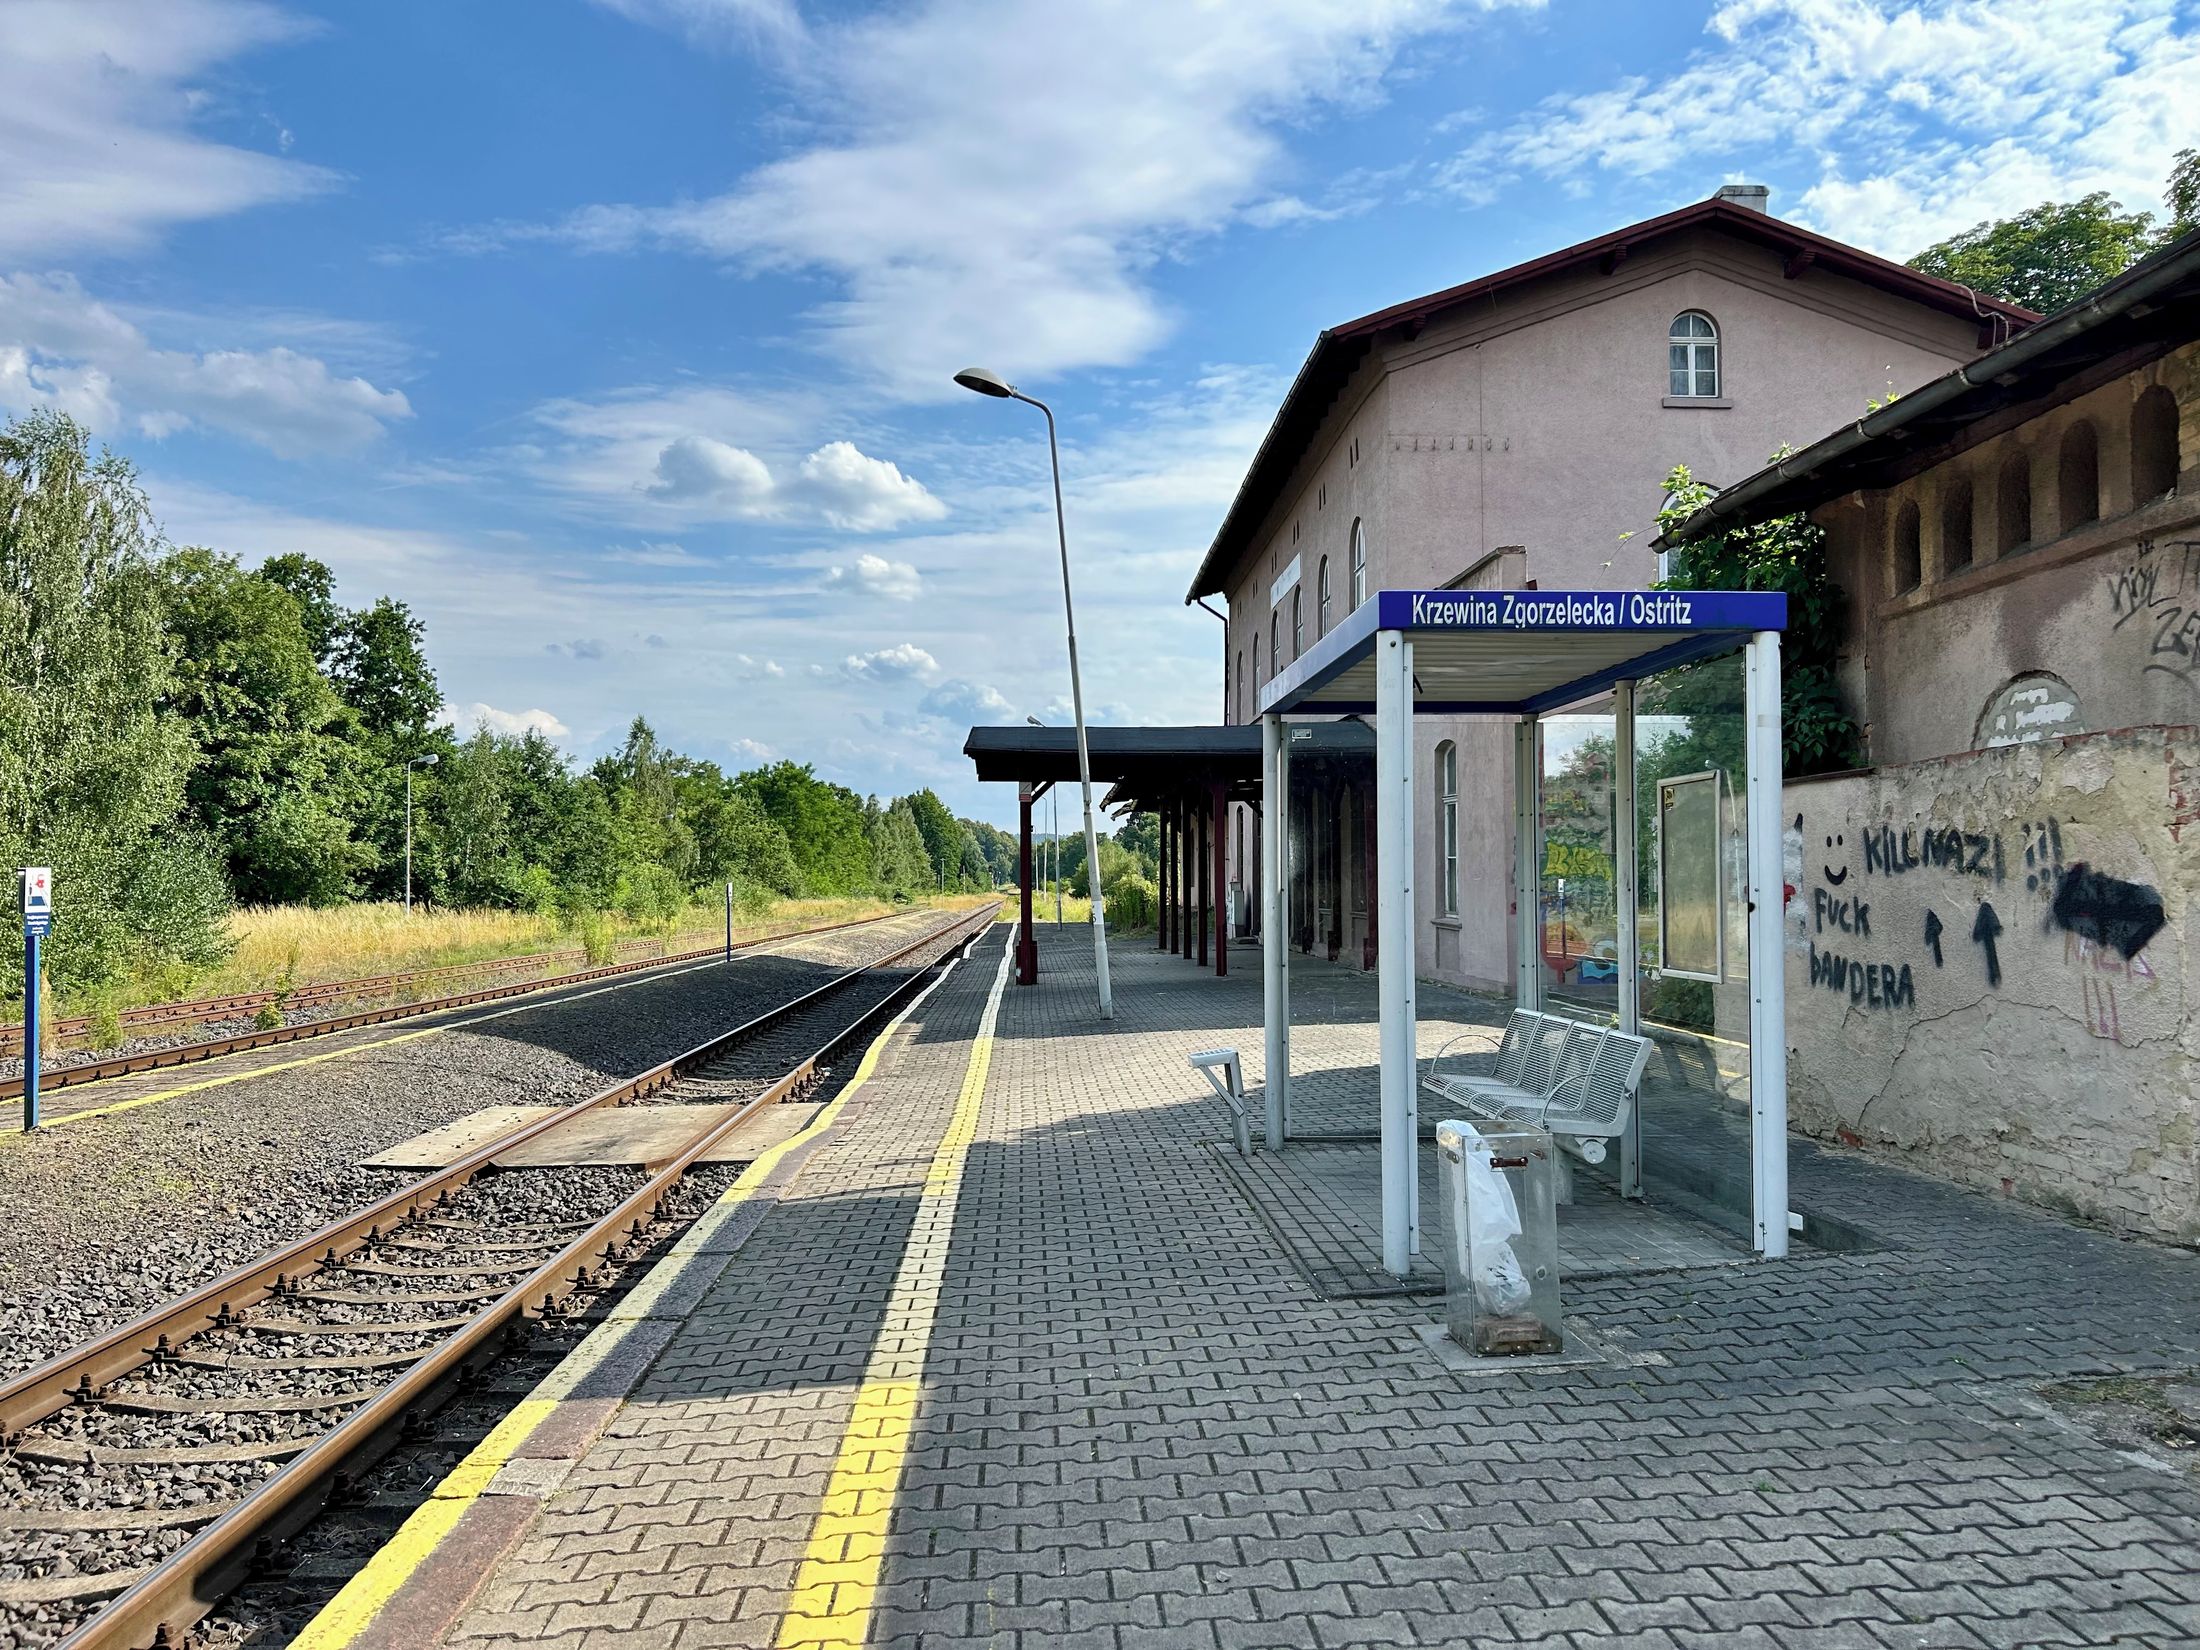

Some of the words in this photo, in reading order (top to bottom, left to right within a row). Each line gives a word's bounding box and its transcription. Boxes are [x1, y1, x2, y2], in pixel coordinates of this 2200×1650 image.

[1412, 594, 1497, 624] Krzewina
[1502, 594, 1615, 628] Zgorzelecka
[1618, 594, 1626, 625] /
[1629, 593, 1692, 625] Ostritz
[1863, 824, 1920, 878] KILL
[1922, 828, 2006, 888] NAZI
